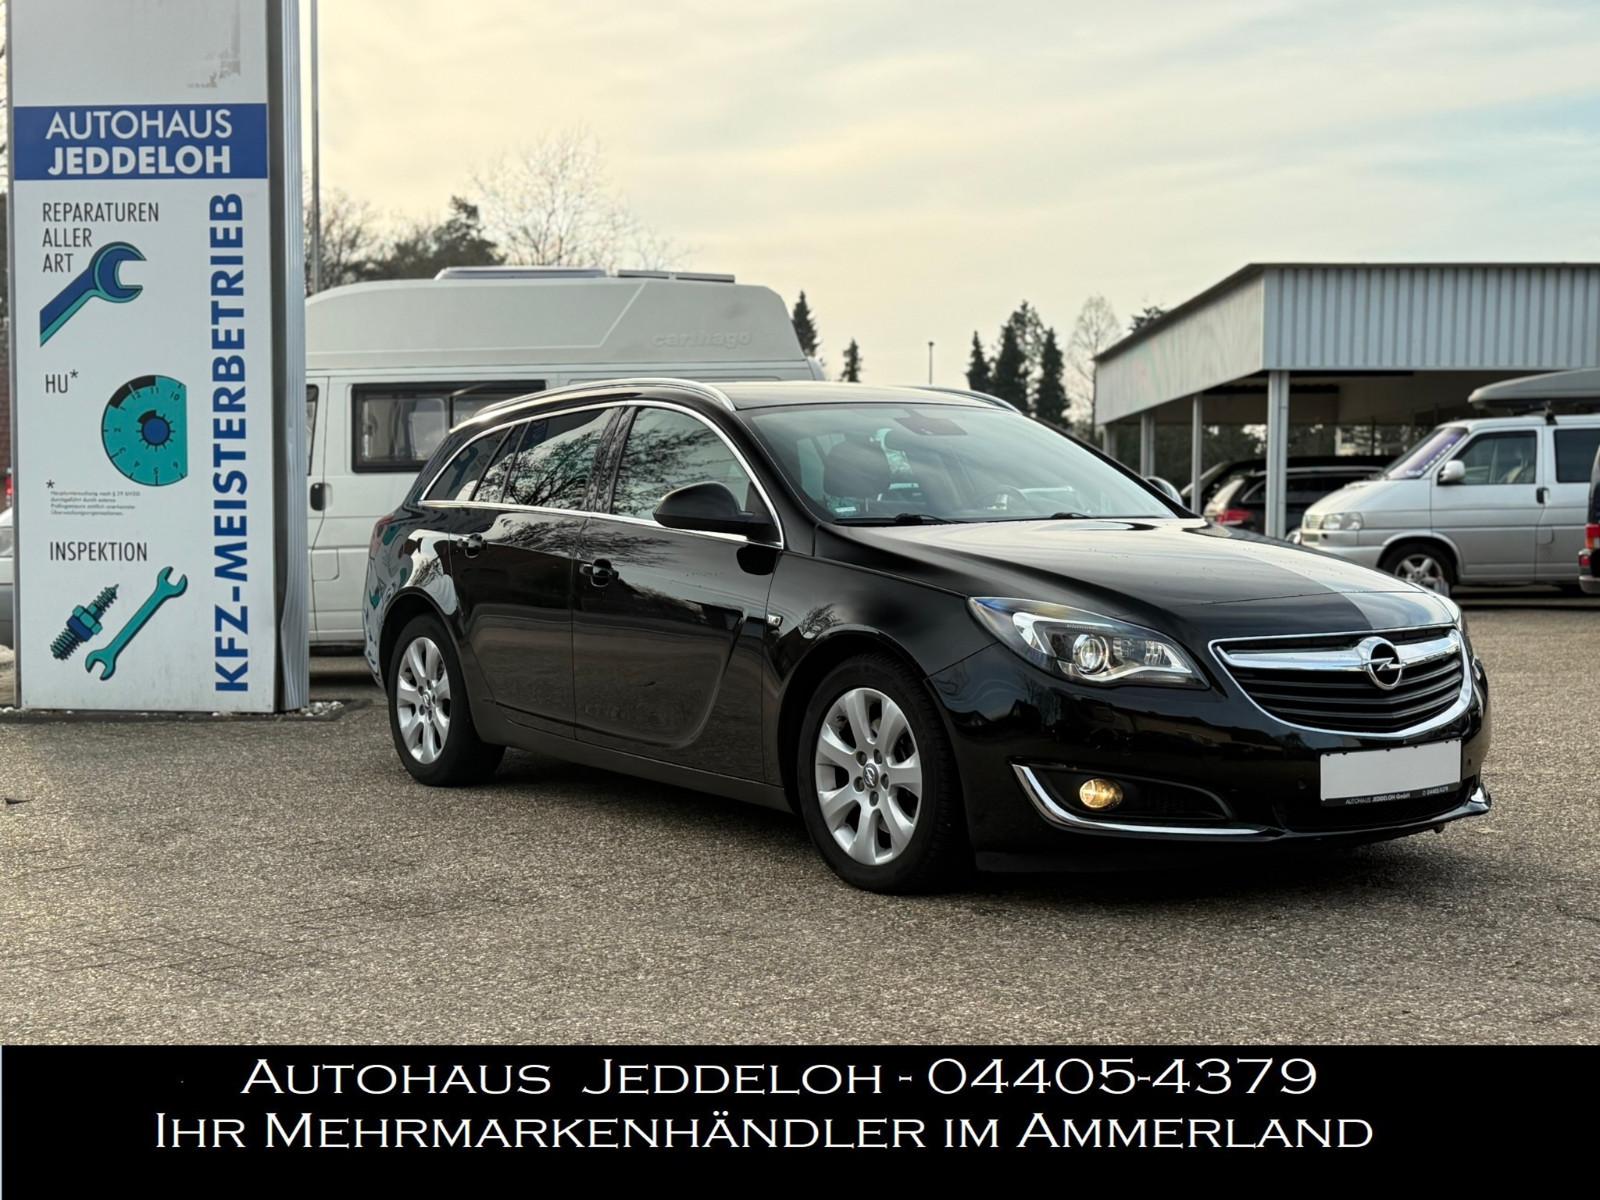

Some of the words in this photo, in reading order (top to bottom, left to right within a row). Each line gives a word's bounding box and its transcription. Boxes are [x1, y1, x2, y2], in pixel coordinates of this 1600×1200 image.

[45, 109, 233, 140] AUTOHAUS
[48, 145, 231, 176] JEDDELOH
[42, 202, 159, 223] REPARATUREN
[42, 228, 92, 248] ALLER
[42, 253, 74, 273] ART
[209, 193, 249, 692] KFZ-MEISTERBETRIEB
[50, 541, 148, 562] INSPEKTION
